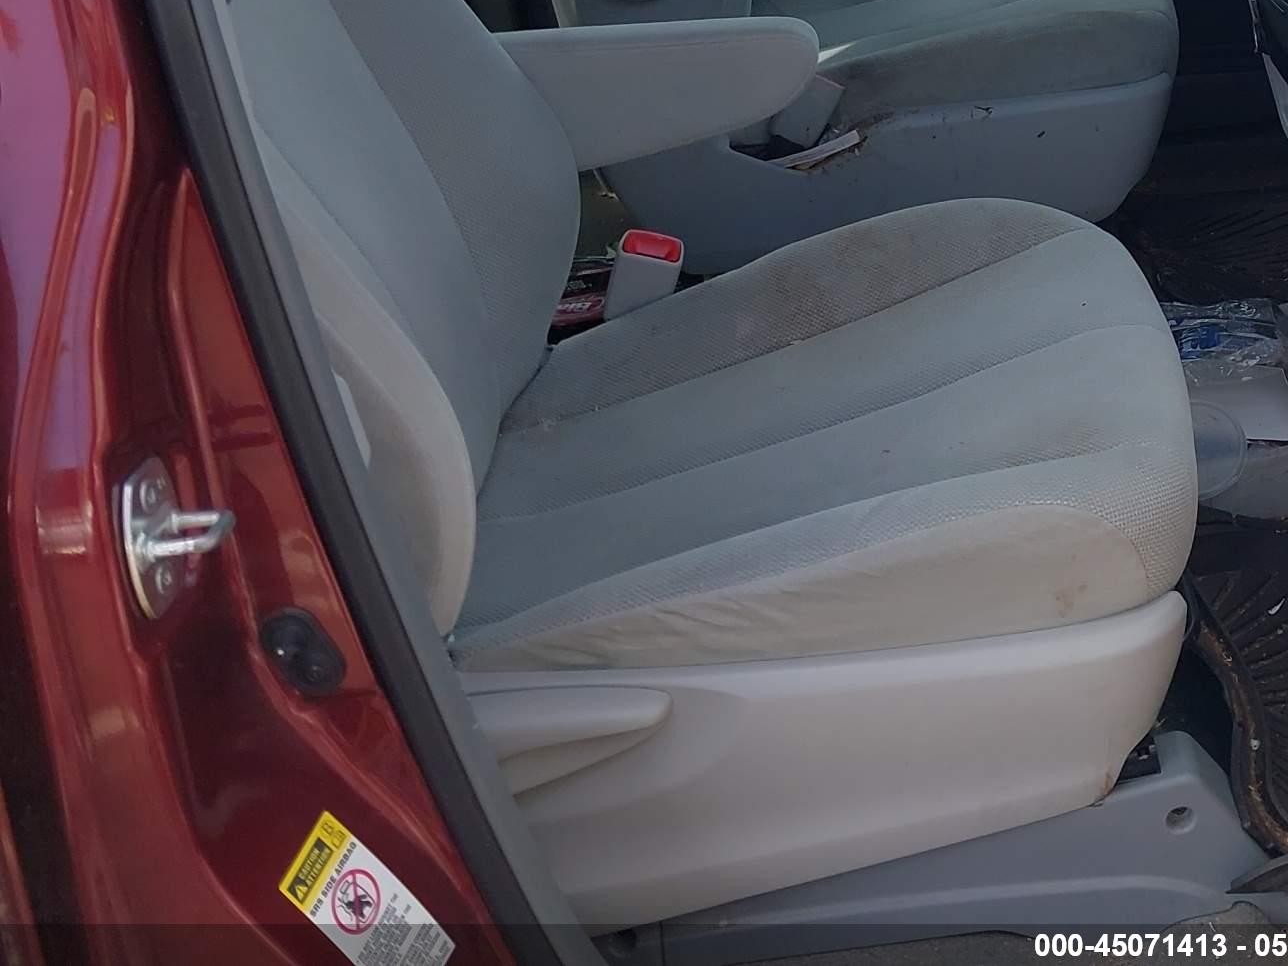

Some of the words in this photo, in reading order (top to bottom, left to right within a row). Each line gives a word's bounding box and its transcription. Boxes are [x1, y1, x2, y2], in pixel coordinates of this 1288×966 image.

[310, 898, 324, 917] SRS
[321, 875, 336, 898] SIDE
[334, 841, 357, 875] AIRBAG
